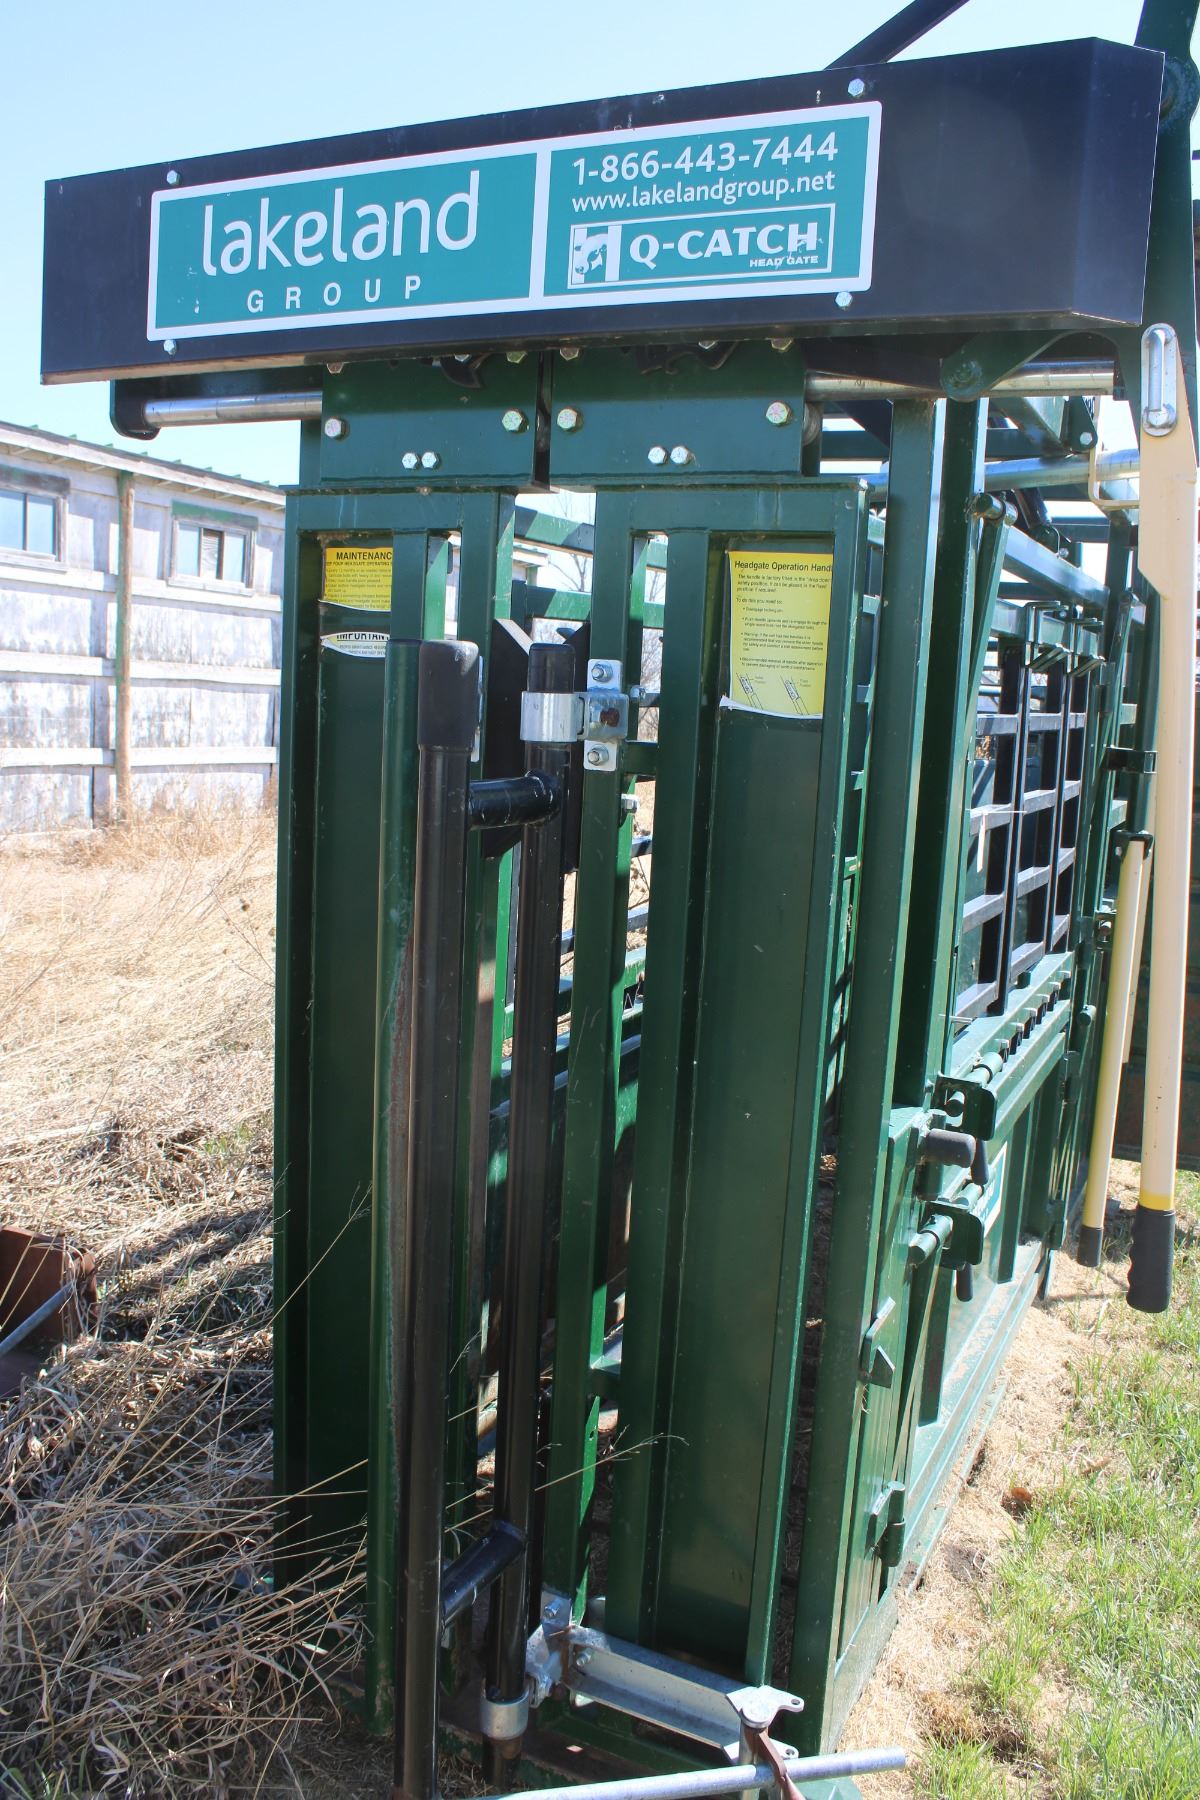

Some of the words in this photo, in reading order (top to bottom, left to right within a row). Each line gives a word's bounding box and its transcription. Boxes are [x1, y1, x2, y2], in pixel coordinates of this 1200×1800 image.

[573, 131, 838, 185] 1-866-443-7444
[572, 170, 835, 212] www.lakelandgroup.net
[203, 170, 479, 276] lakeland
[629, 222, 818, 270] Q-CATCH
[749, 258, 784, 268] HEAD
[786, 255, 819, 265] GATE
[246, 275, 421, 313] GROUP
[336, 552, 392, 560] MAINTENANC
[734, 561, 770, 571] Headgate
[772, 562, 808, 572] Operation
[811, 564, 832, 572] Hand
